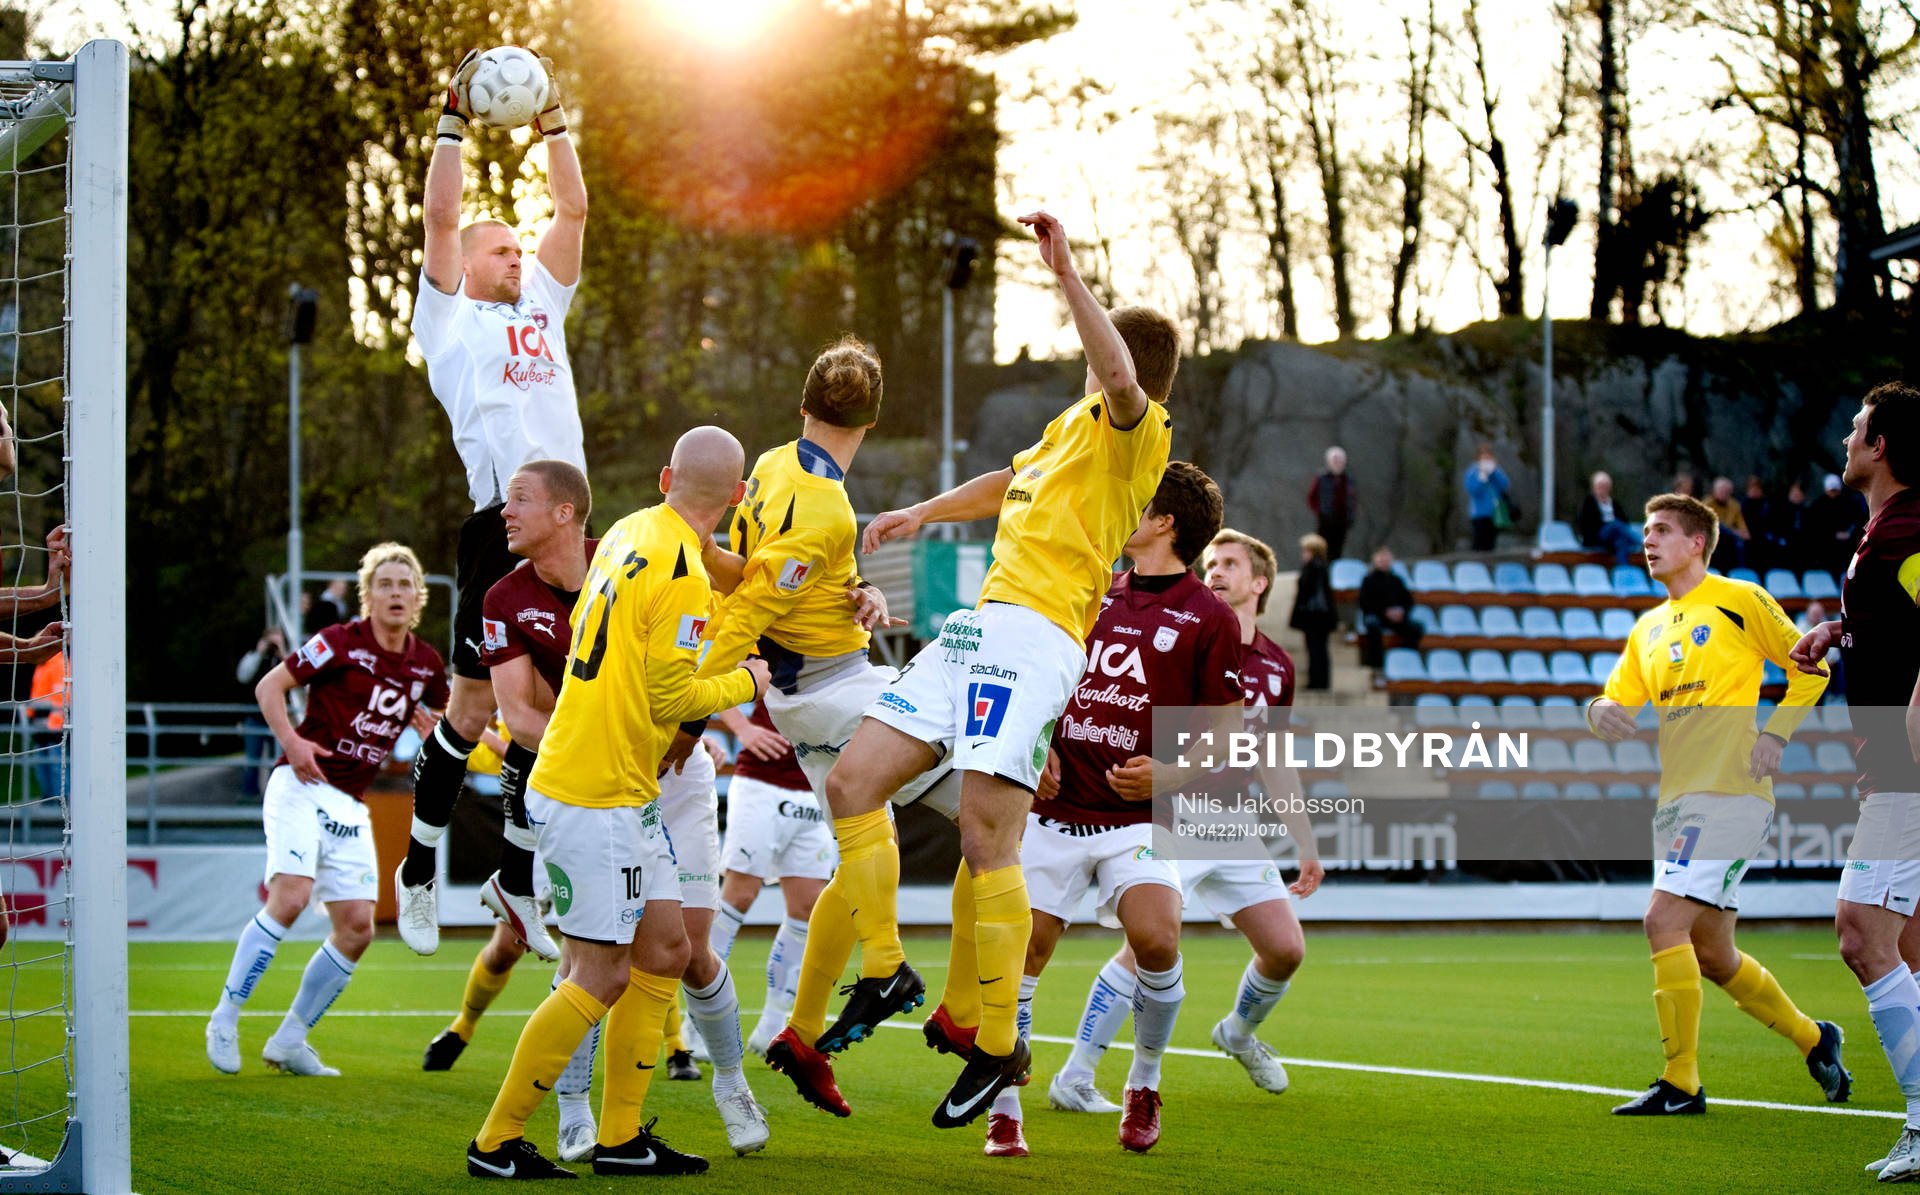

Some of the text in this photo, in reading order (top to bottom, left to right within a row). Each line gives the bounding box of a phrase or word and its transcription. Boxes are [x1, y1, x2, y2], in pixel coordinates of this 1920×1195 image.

[969, 663, 1018, 681] stadium
[1087, 639, 1147, 685] ICA
[367, 685, 407, 721] ICA
[1073, 678, 1150, 712] Kundkort
[621, 866, 642, 900] 10
[1081, 982, 1117, 1043] Folksam
